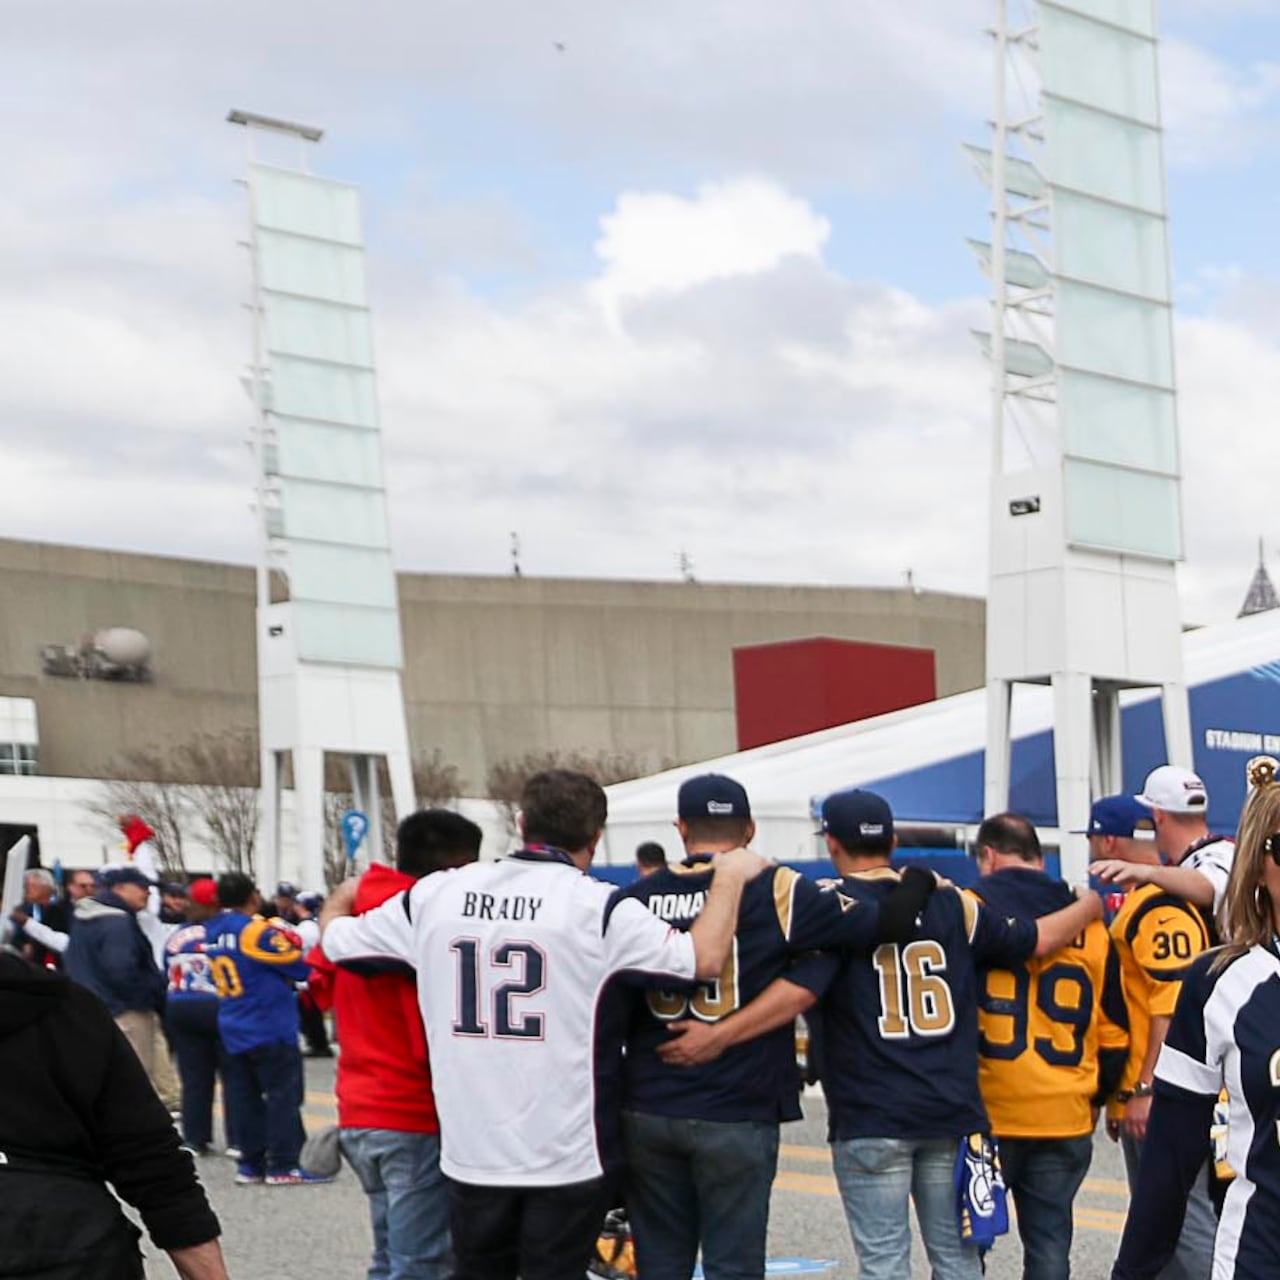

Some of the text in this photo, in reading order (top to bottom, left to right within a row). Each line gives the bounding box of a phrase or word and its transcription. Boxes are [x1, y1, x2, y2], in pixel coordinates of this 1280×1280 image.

[1205, 728, 1262, 751] STADIUM
[461, 891, 543, 921] BRADY
[649, 889, 710, 919] DONA
[1152, 930, 1191, 960] 30
[449, 935, 547, 1042] 12
[873, 940, 955, 1040] 16
[977, 962, 1093, 1067] 99
